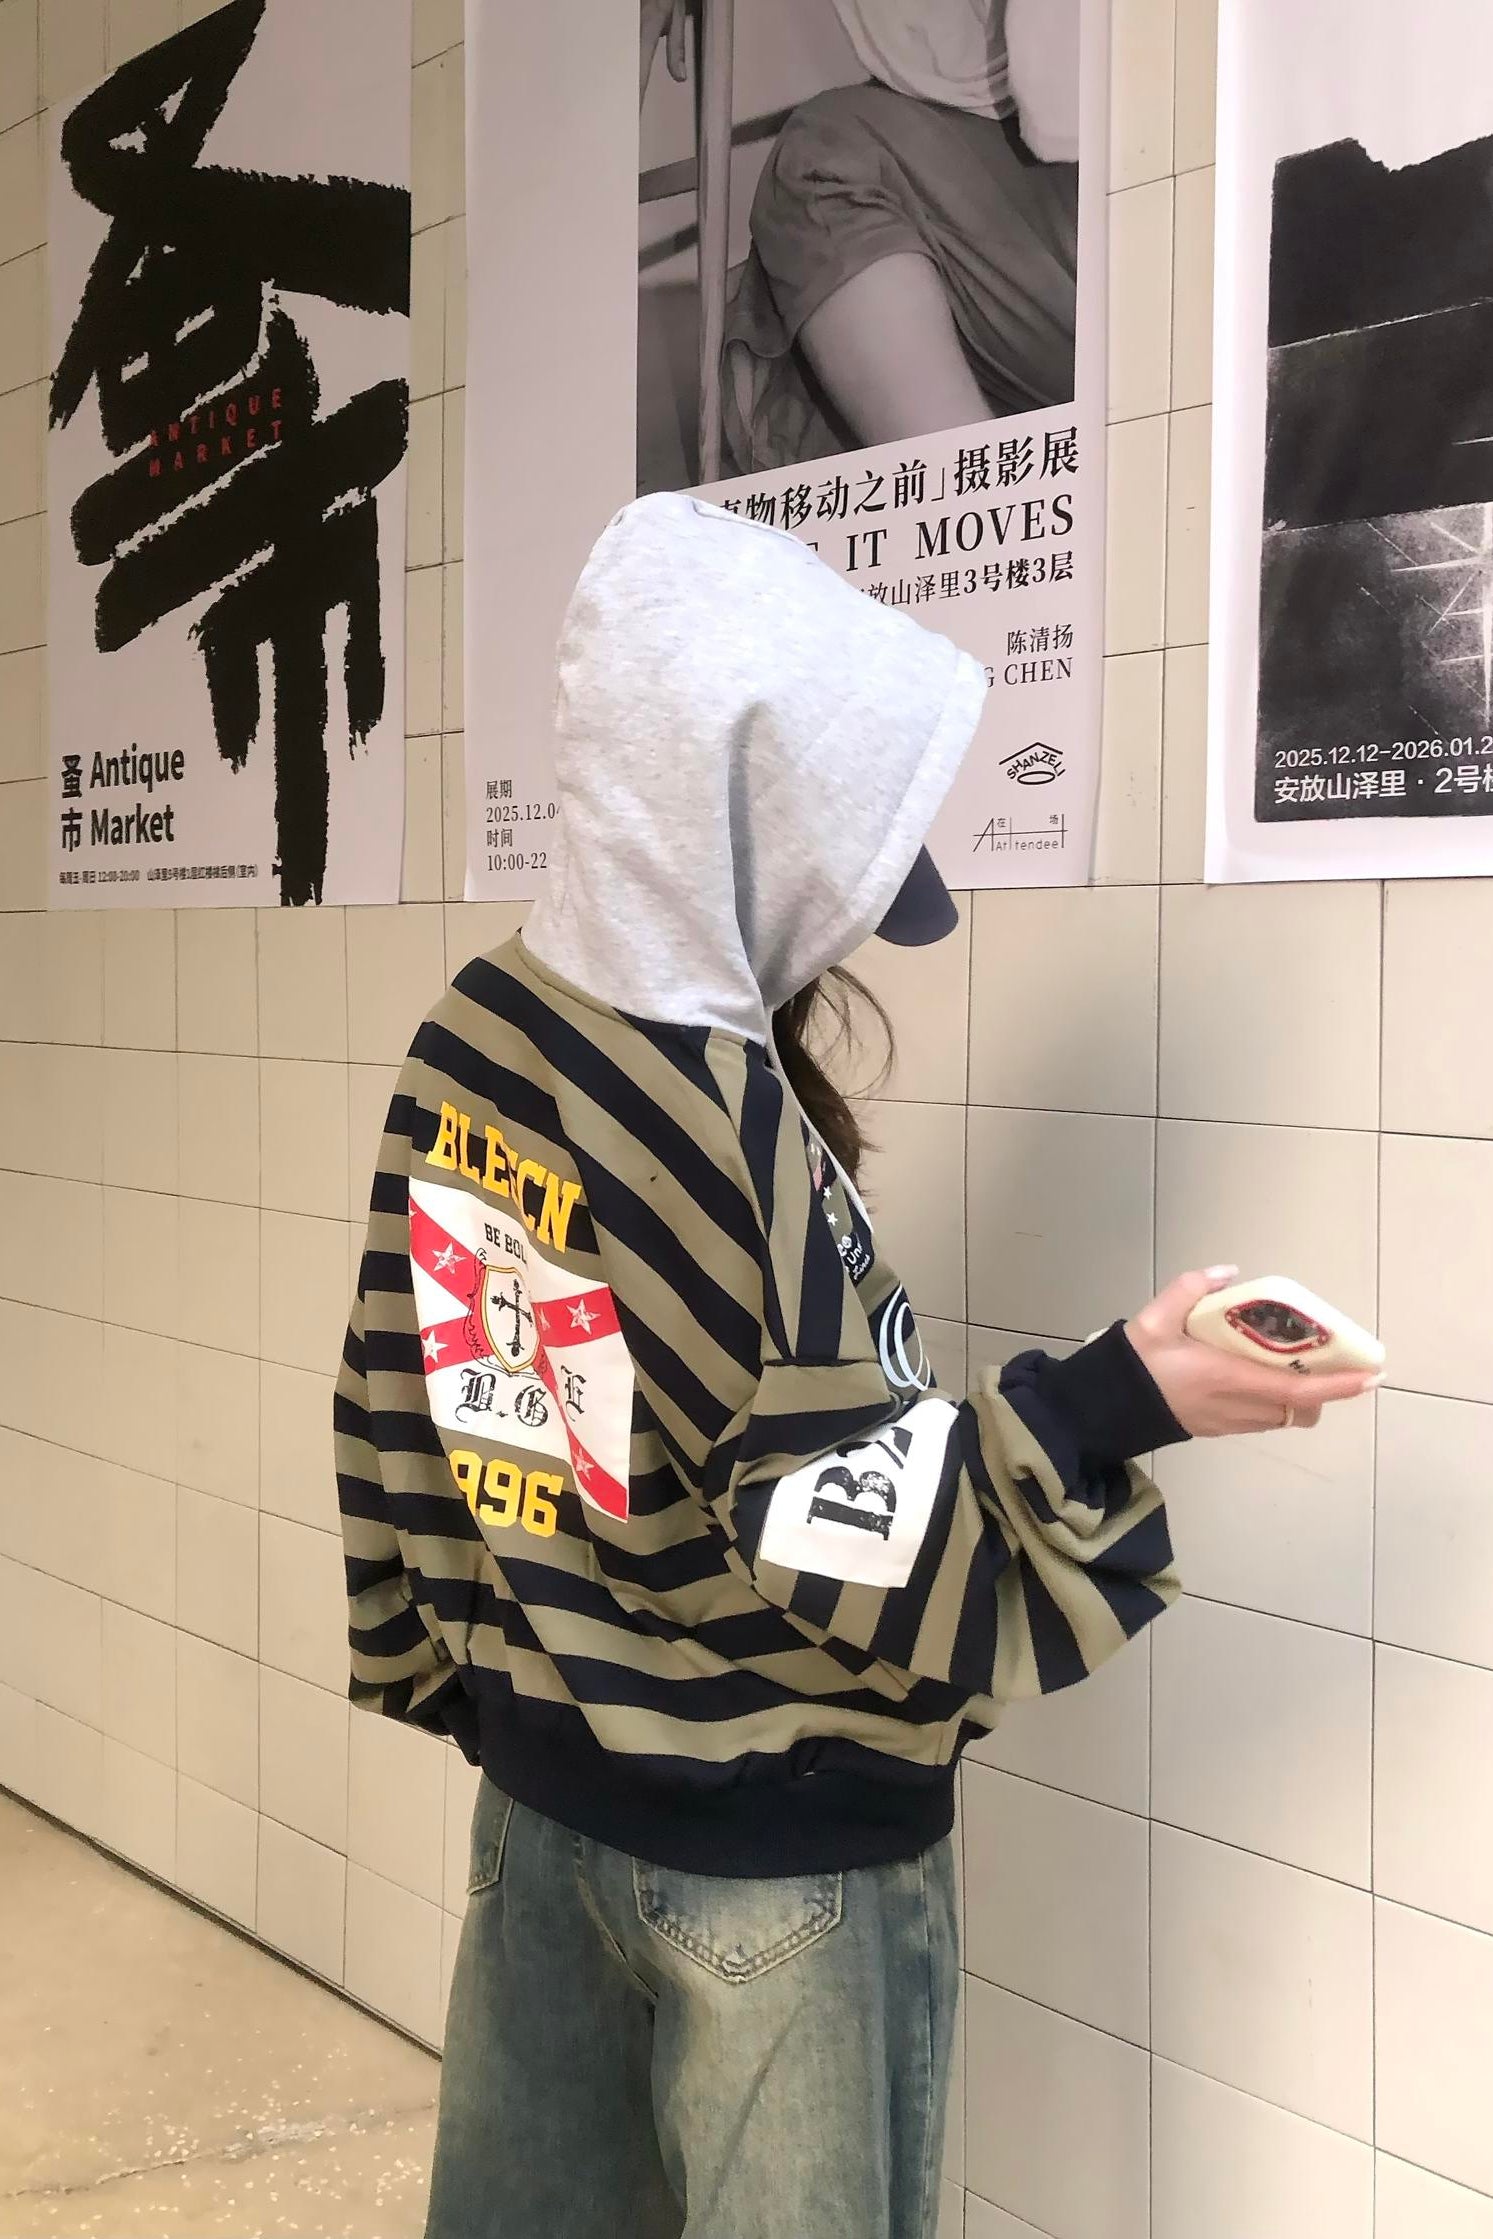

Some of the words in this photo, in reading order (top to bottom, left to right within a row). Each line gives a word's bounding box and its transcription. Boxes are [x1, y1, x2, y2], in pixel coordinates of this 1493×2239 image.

[150, 387, 282, 447] ANTIQUE
[149, 420, 282, 477] MARKET
[846, 529, 888, 572] IT
[914, 493, 1074, 560] MOVES
[861, 550, 1074, 606] 放山泽里3号楼3层
[1007, 623, 1073, 656] 陈清扬
[1004, 657, 1073, 686] CHEN
[89, 742, 185, 793] Antique
[1006, 750, 1066, 780] SHANZELI
[486, 779, 512, 800] 展期
[91, 802, 175, 847] Market
[486, 802, 560, 823] 2025.12.0
[486, 828, 513, 848] 时间
[487, 852, 547, 871] 10:00-22
[484, 1222, 501, 1248] BE
